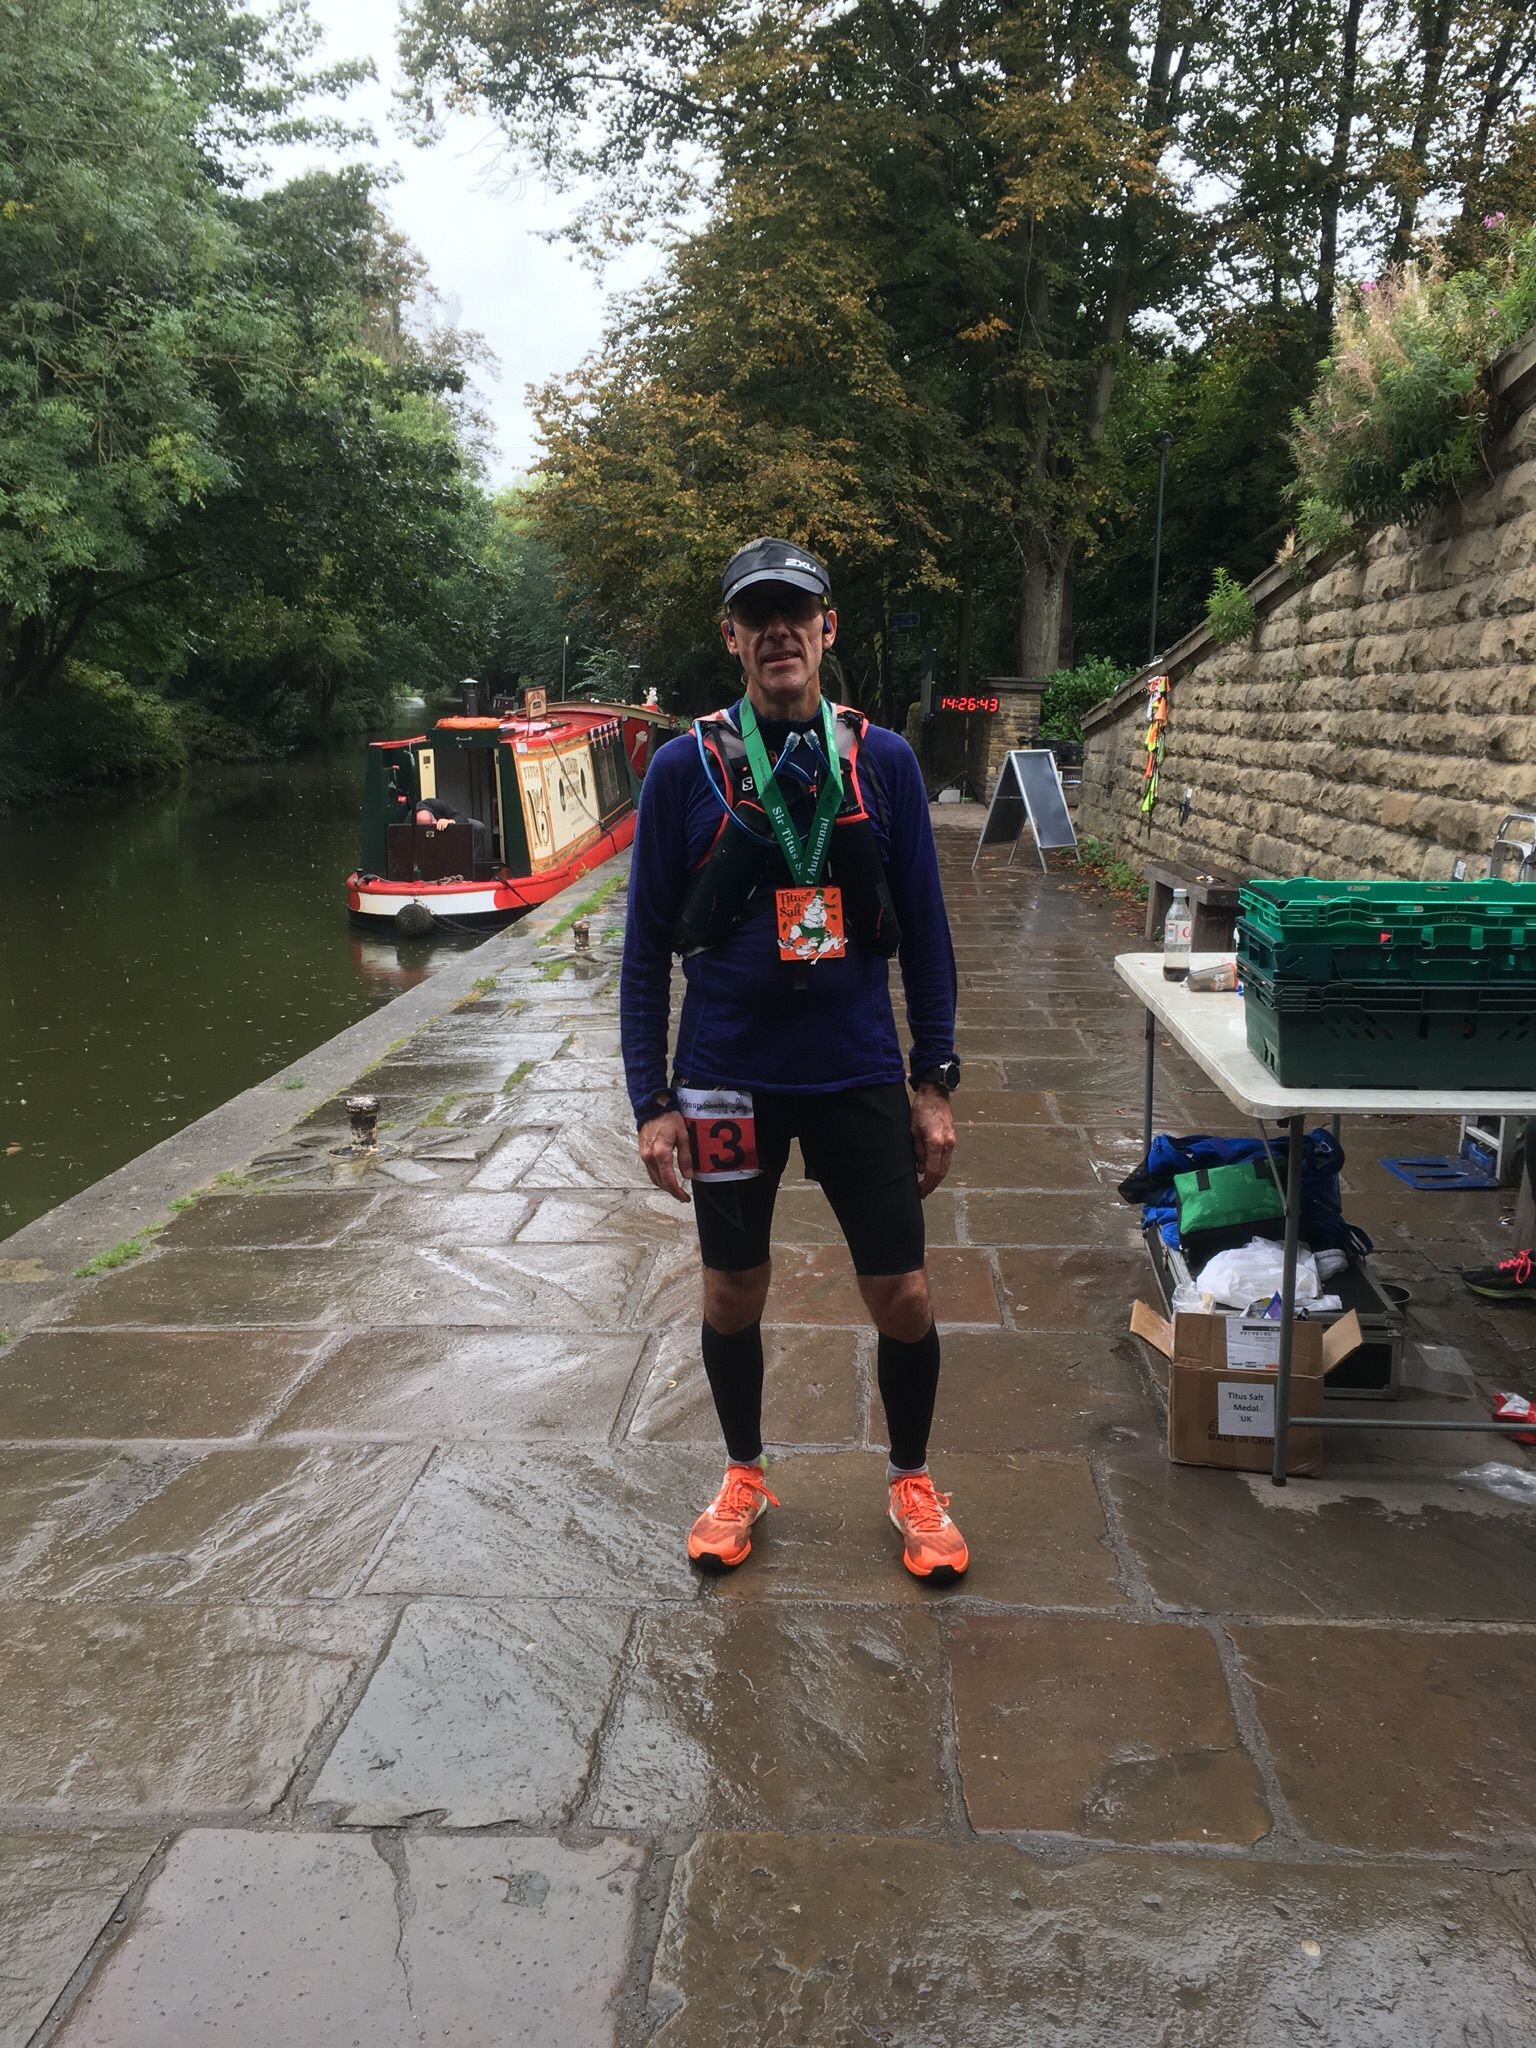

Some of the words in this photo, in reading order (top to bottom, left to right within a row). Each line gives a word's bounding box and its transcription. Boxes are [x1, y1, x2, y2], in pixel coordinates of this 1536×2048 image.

[941, 697, 999, 712] 14:26:43
[772, 806, 785, 825] Sir
[782, 828, 799, 860] Titus
[807, 817, 830, 877] Autumnal
[778, 892, 807, 906] Titus
[780, 903, 801, 917] Salt
[1442, 915, 1467, 923] IFCO
[687, 1119, 746, 1170] 13
[1228, 1392, 1247, 1400] Titus
[1249, 1392, 1265, 1401] Salt
[1233, 1404, 1259, 1412] Medal
[1252, 1437, 1275, 1446] CHIN
